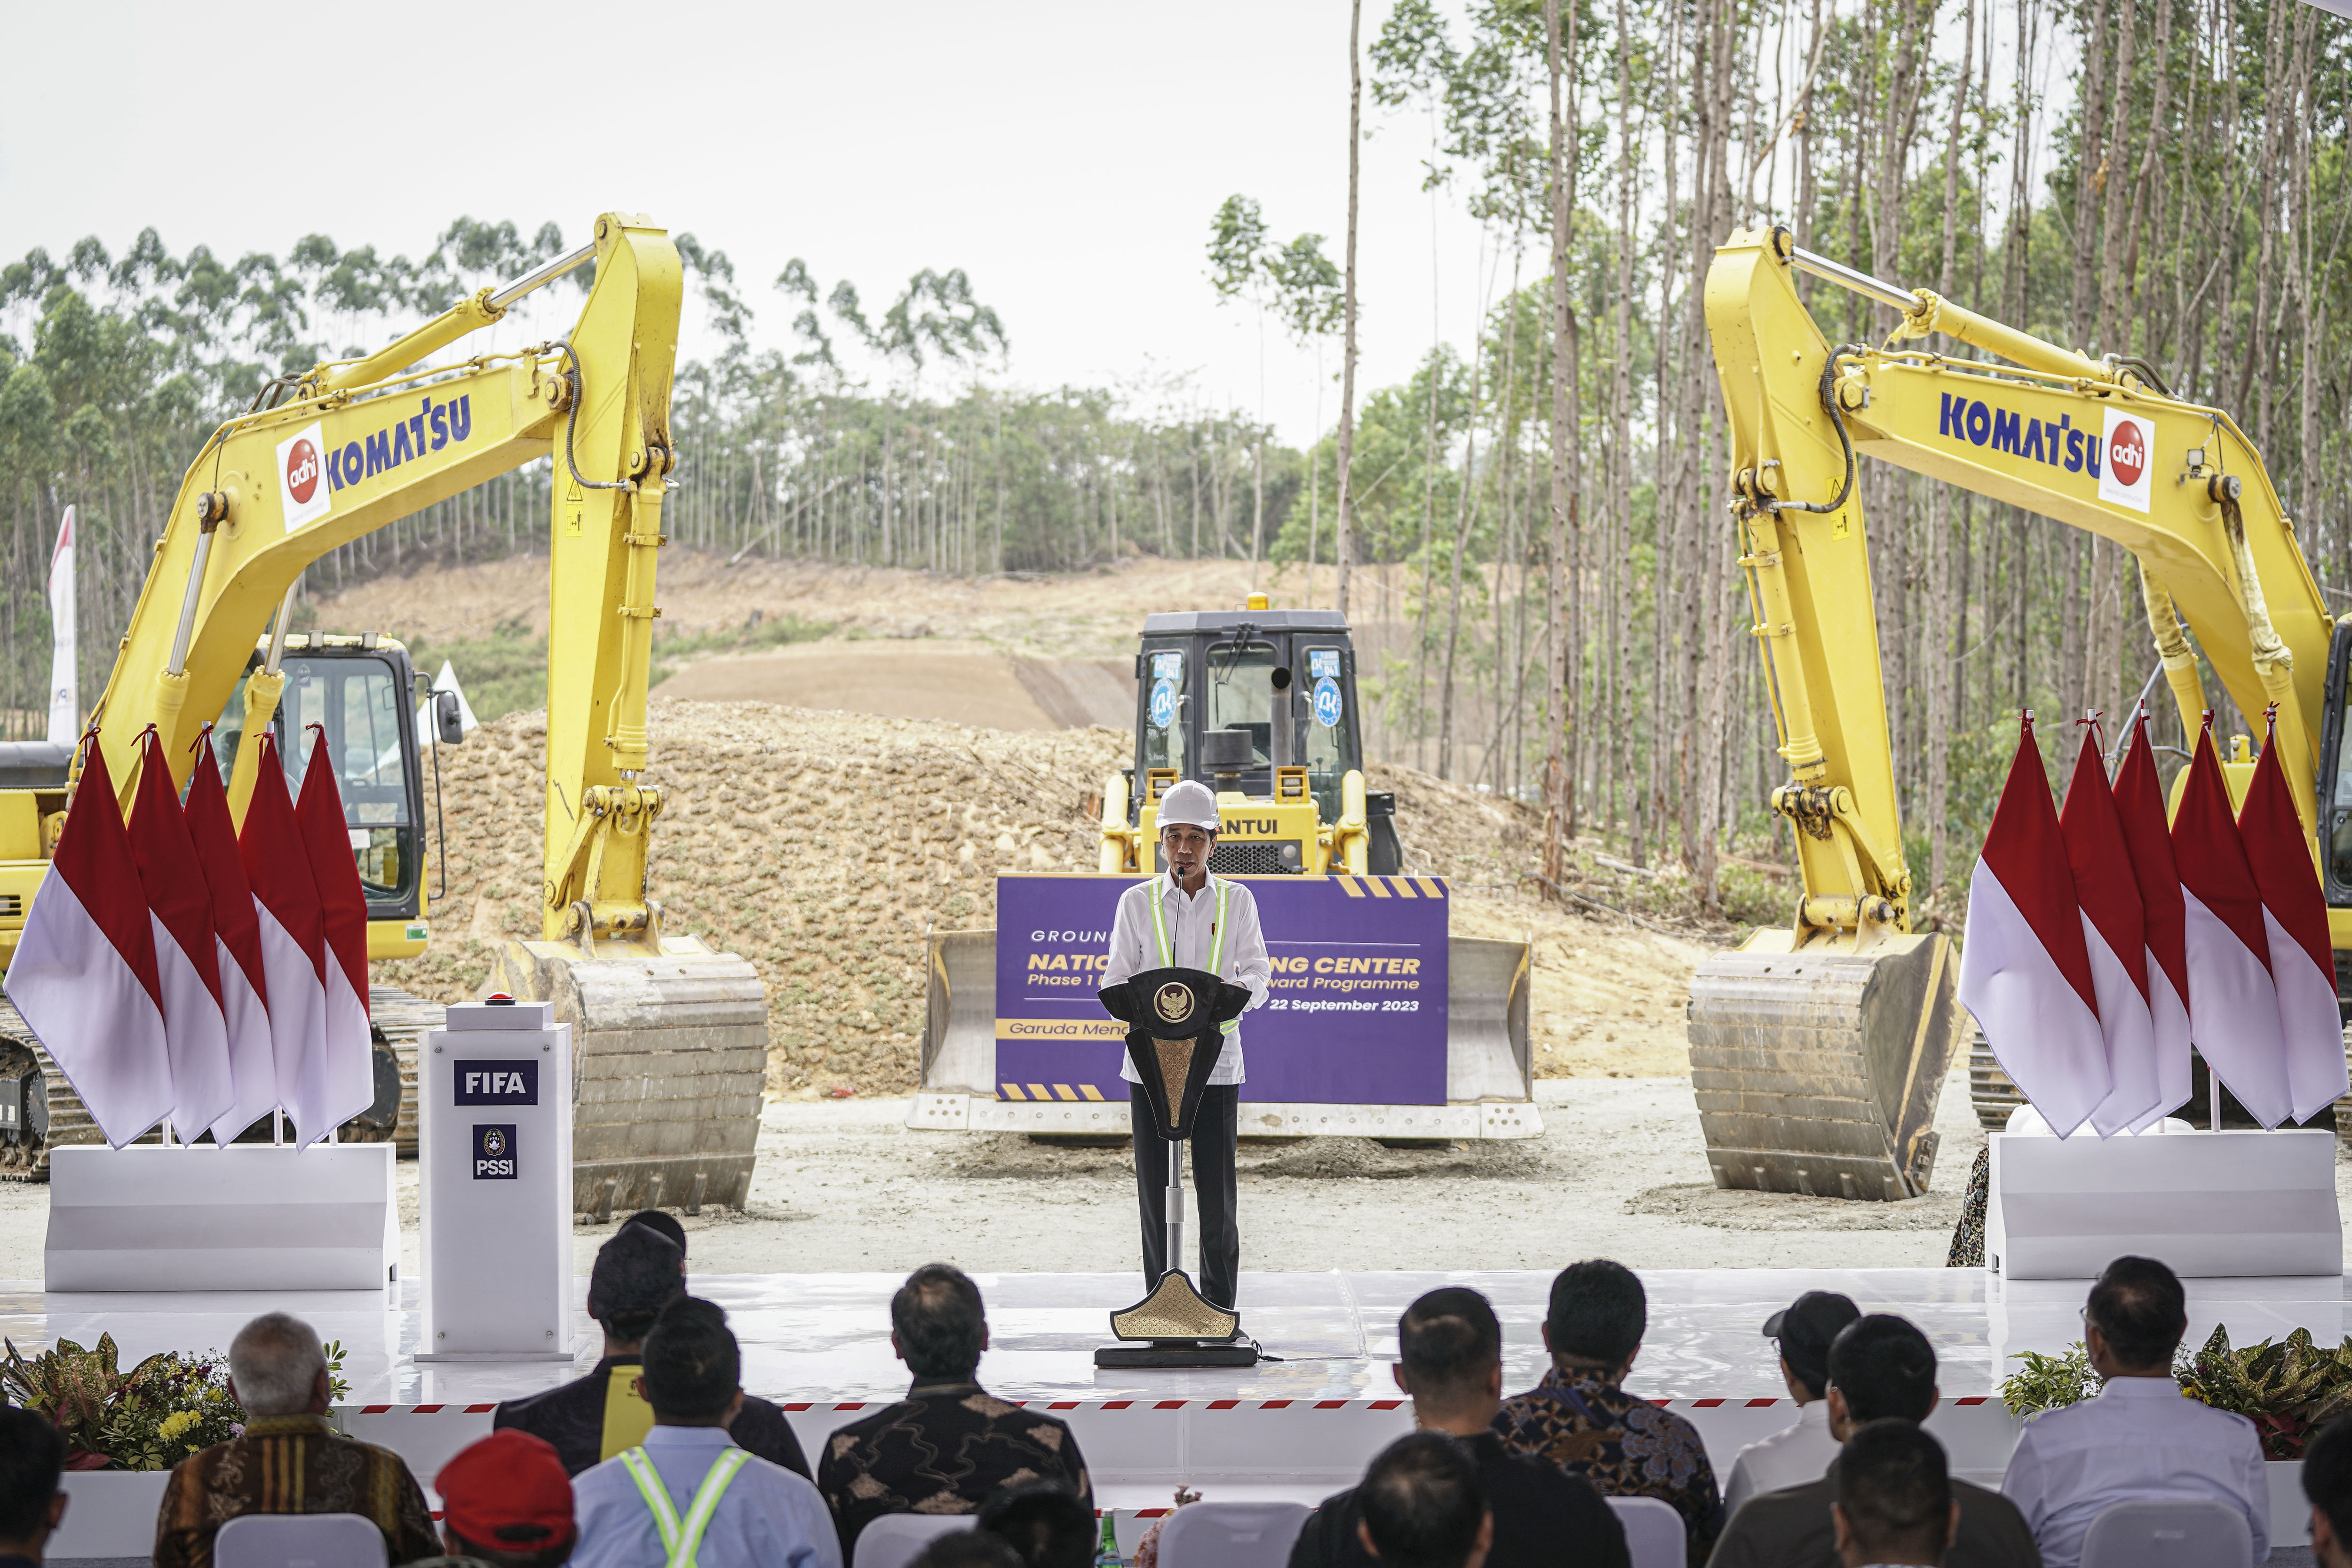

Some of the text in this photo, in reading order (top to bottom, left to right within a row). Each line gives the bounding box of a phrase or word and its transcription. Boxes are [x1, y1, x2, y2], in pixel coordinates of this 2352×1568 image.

[1939, 392, 2102, 479] KOMATSU
[325, 394, 471, 494] KOMATSU
[2112, 443, 2143, 469] adhi
[289, 454, 317, 488] adhi
[1031, 930, 1112, 942] GROUN
[1314, 957, 1421, 974] CENTER
[1027, 974, 1081, 986] Phase
[1088, 974, 1093, 986] 1
[1313, 978, 1420, 993] Programme
[1269, 999, 1419, 1013] 22 September 2023
[1010, 1023, 1077, 1035] Garuda
[466, 1072, 526, 1093] FIFA
[477, 1159, 513, 1175] PSSI
